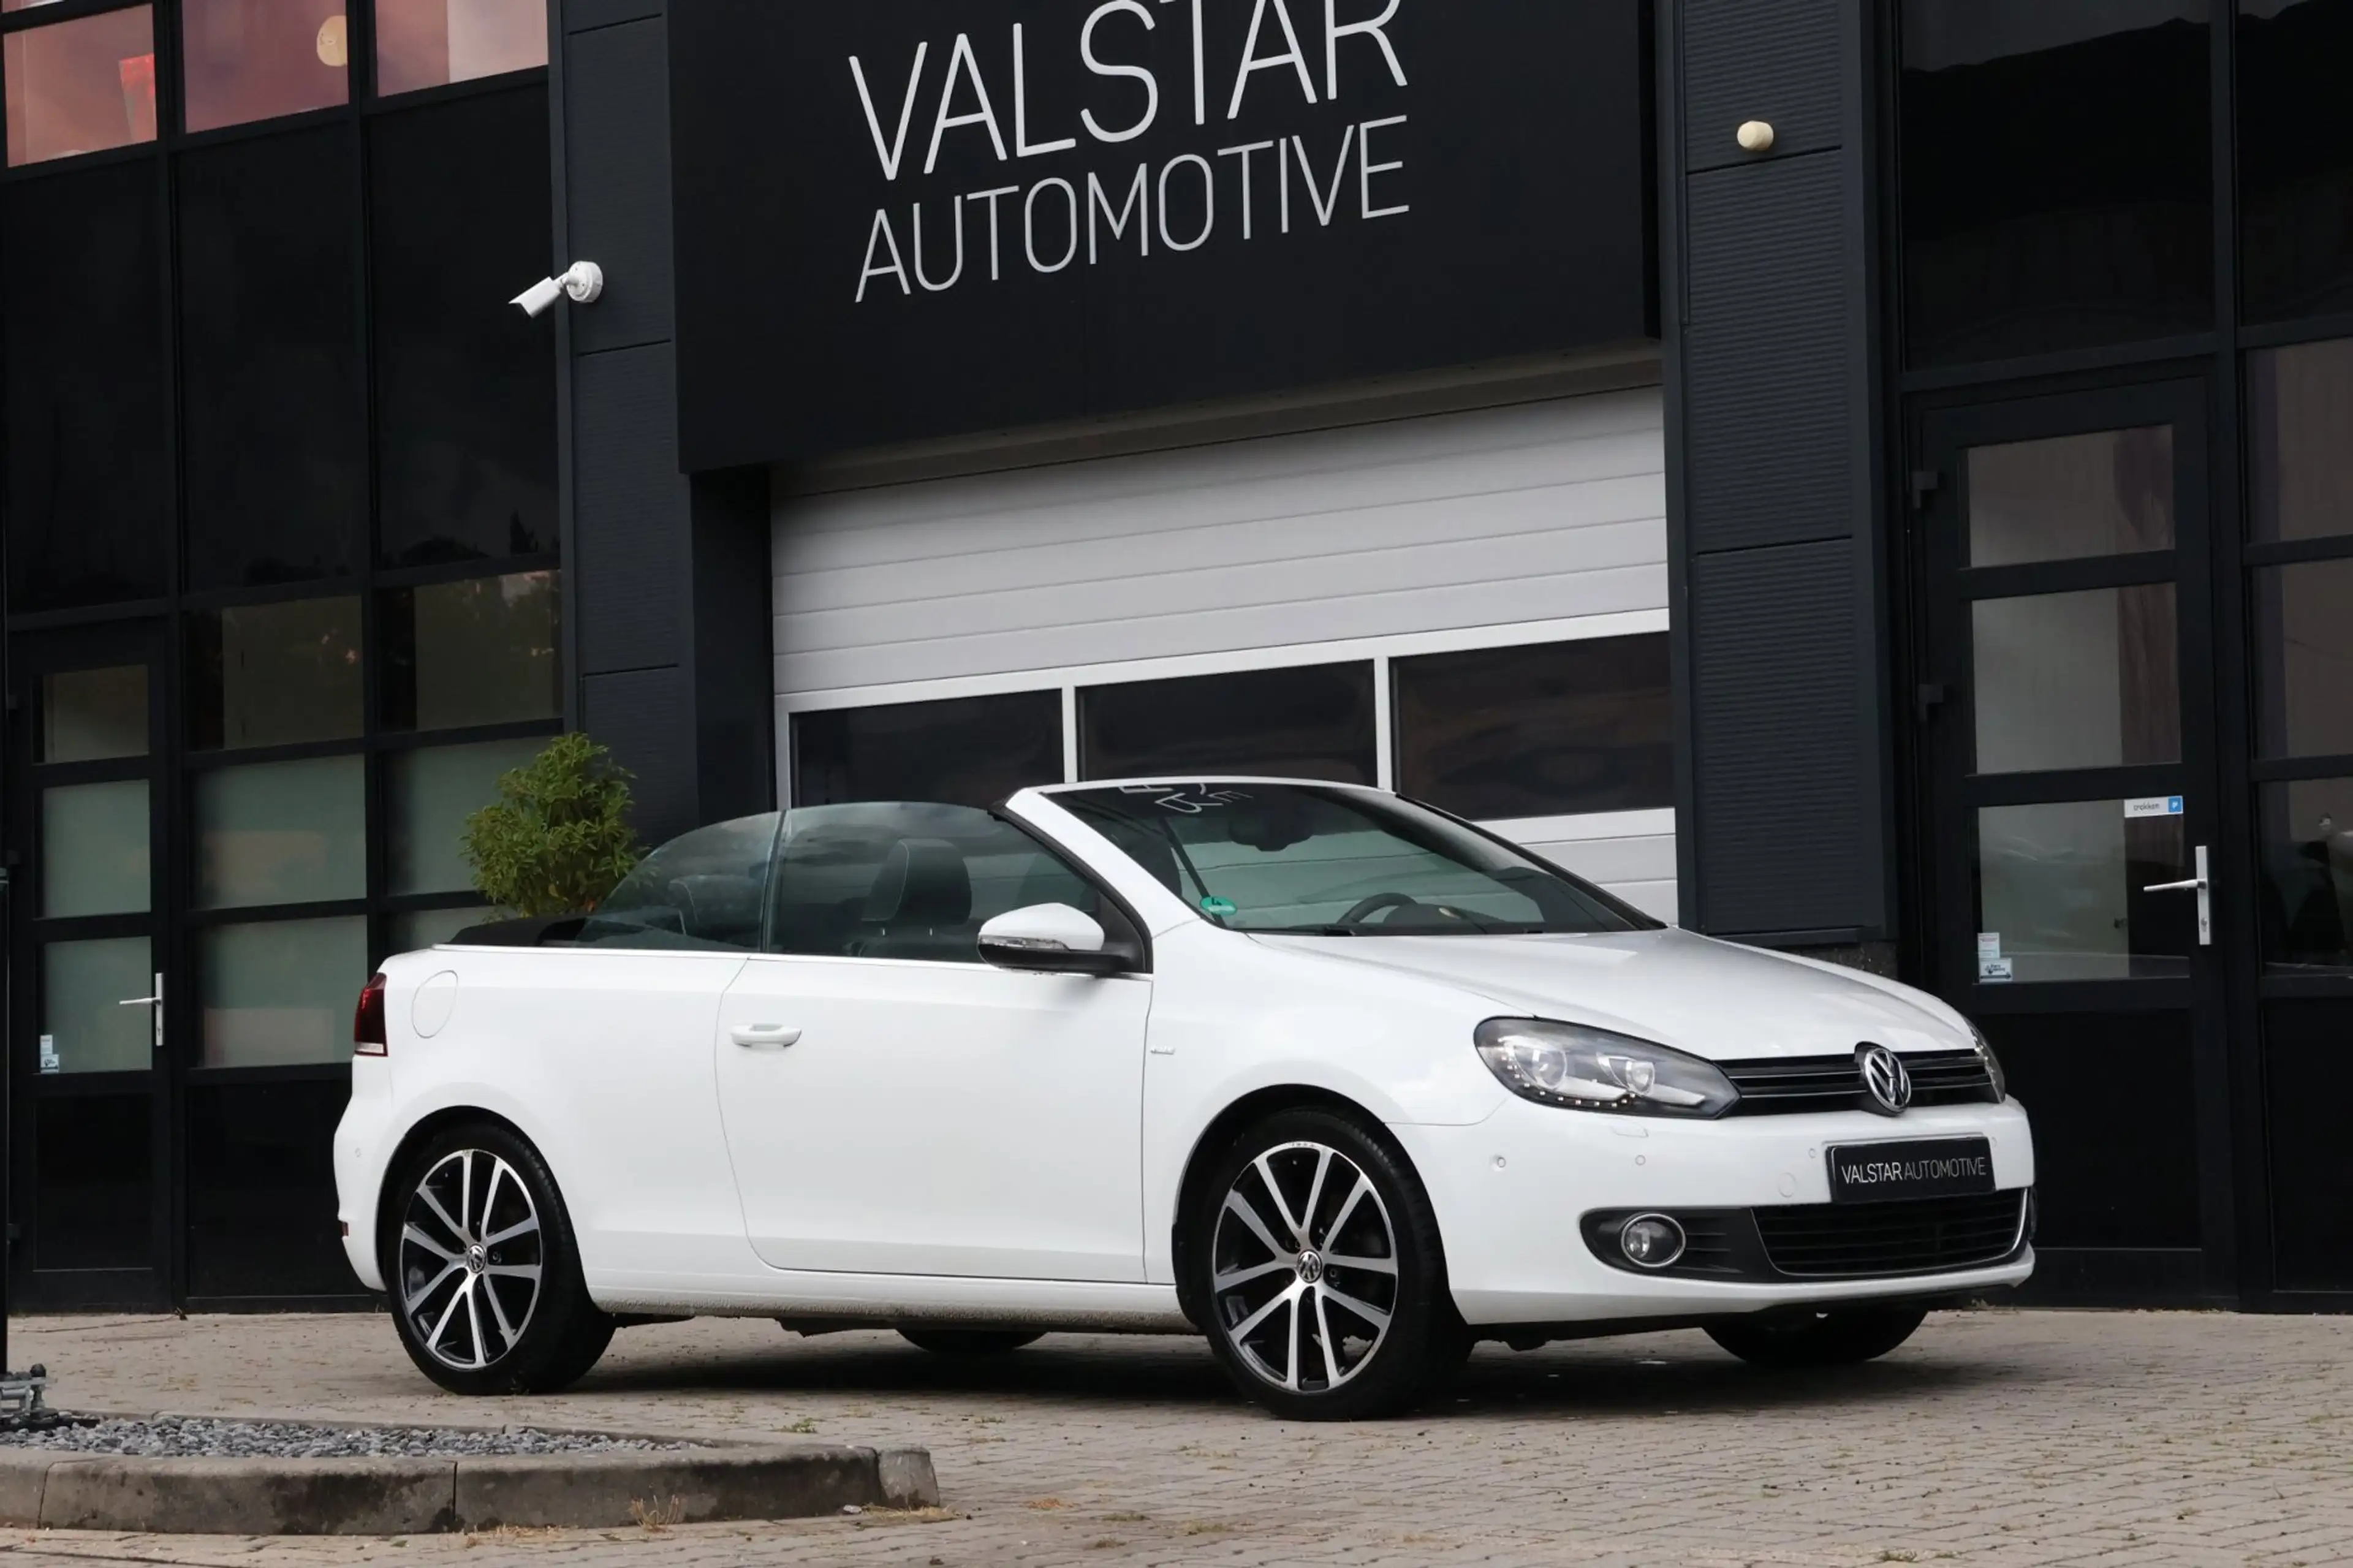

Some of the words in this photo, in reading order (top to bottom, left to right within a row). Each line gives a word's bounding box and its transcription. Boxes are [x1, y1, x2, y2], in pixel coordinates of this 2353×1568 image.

[848, 0, 1408, 181] VALSTAR
[855, 115, 1410, 303] AUTOMOTIVE
[1841, 1162, 1903, 1184] VALSTAR
[1903, 1157, 1986, 1180] AUTOMOTIVE
